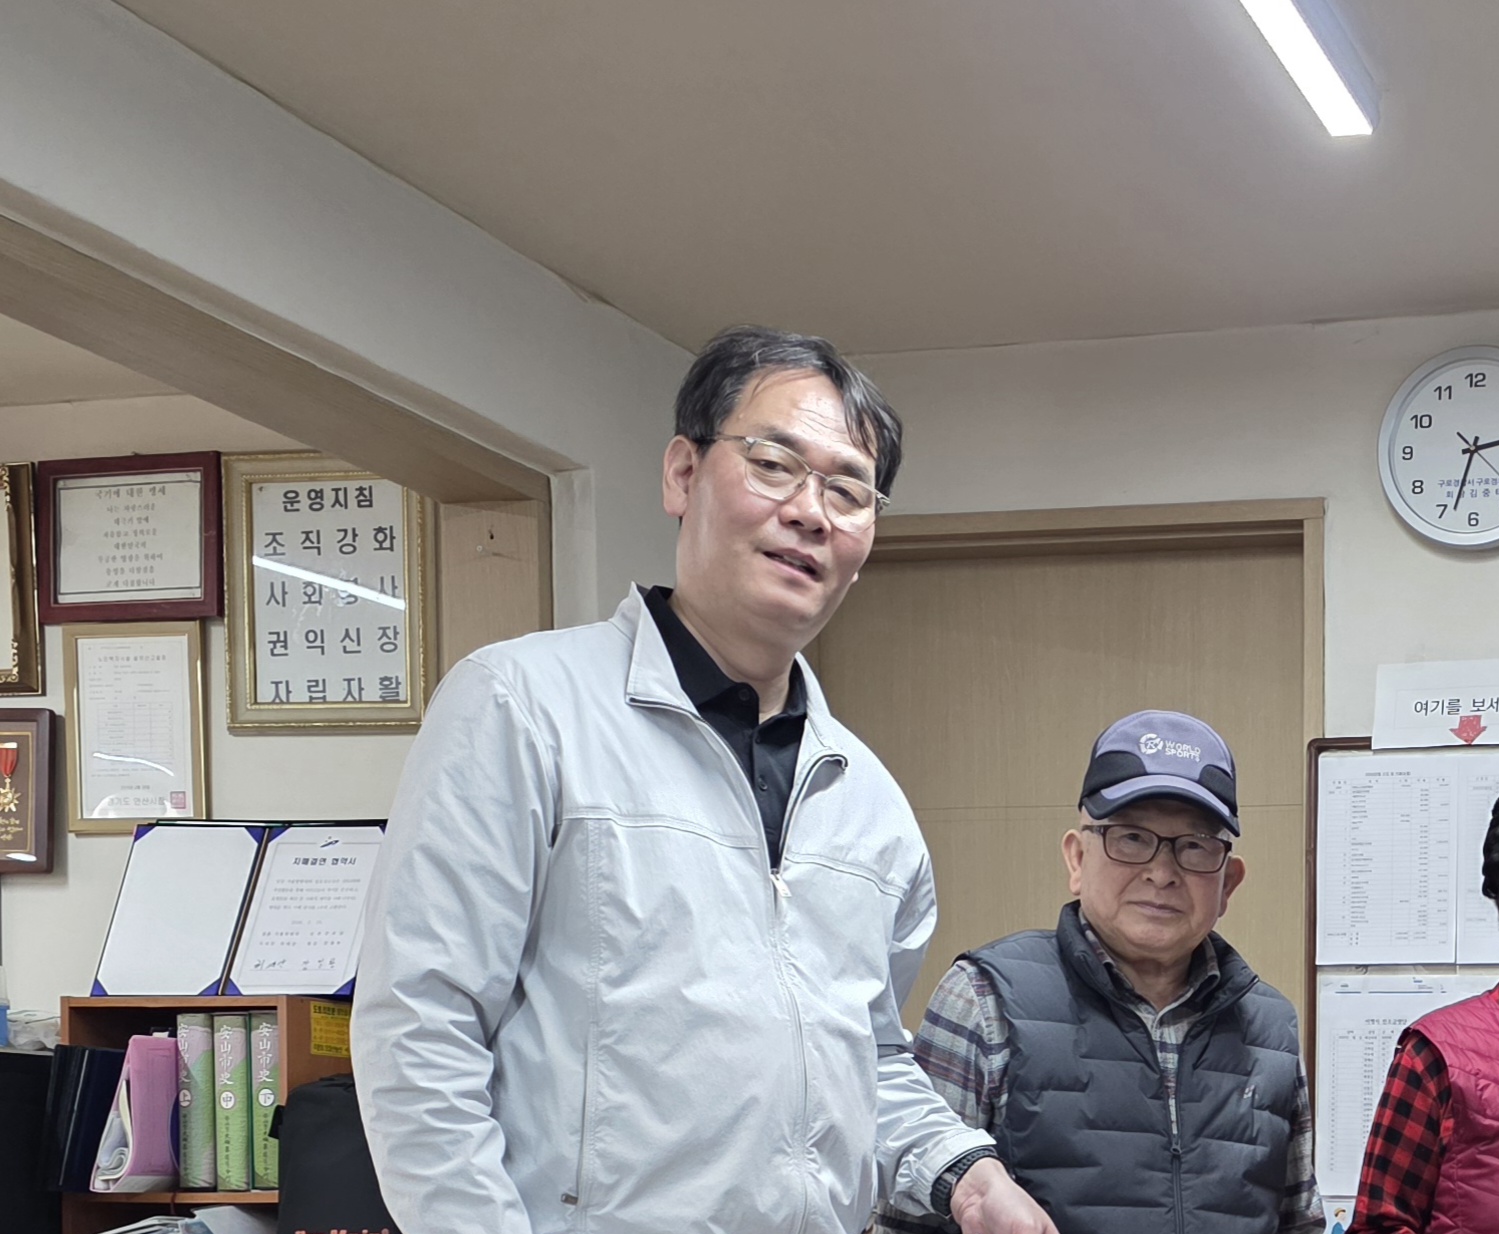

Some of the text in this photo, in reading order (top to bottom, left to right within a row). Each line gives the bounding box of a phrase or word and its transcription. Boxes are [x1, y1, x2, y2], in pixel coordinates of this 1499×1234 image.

[1464, 372, 1487, 388] 12
[1433, 385, 1453, 401] 11
[1409, 414, 1433, 430] 10
[1401, 445, 1414, 461] 9
[1411, 479, 1425, 495] 8
[1437, 478, 1475, 488] 구로경서
[282, 485, 374, 513] 운영지침
[1435, 503, 1449, 519] 7
[1467, 511, 1480, 527] 6
[263, 525, 397, 557] 조직강화
[267, 625, 400, 657] 권익신장
[270, 675, 402, 703] 자립자활
[1414, 698, 1462, 716] 여기를
[1165, 740, 1201, 755] WORLD
[219, 1025, 234, 1085] 安山市史
[258, 1022, 274, 1083] 安山市史
